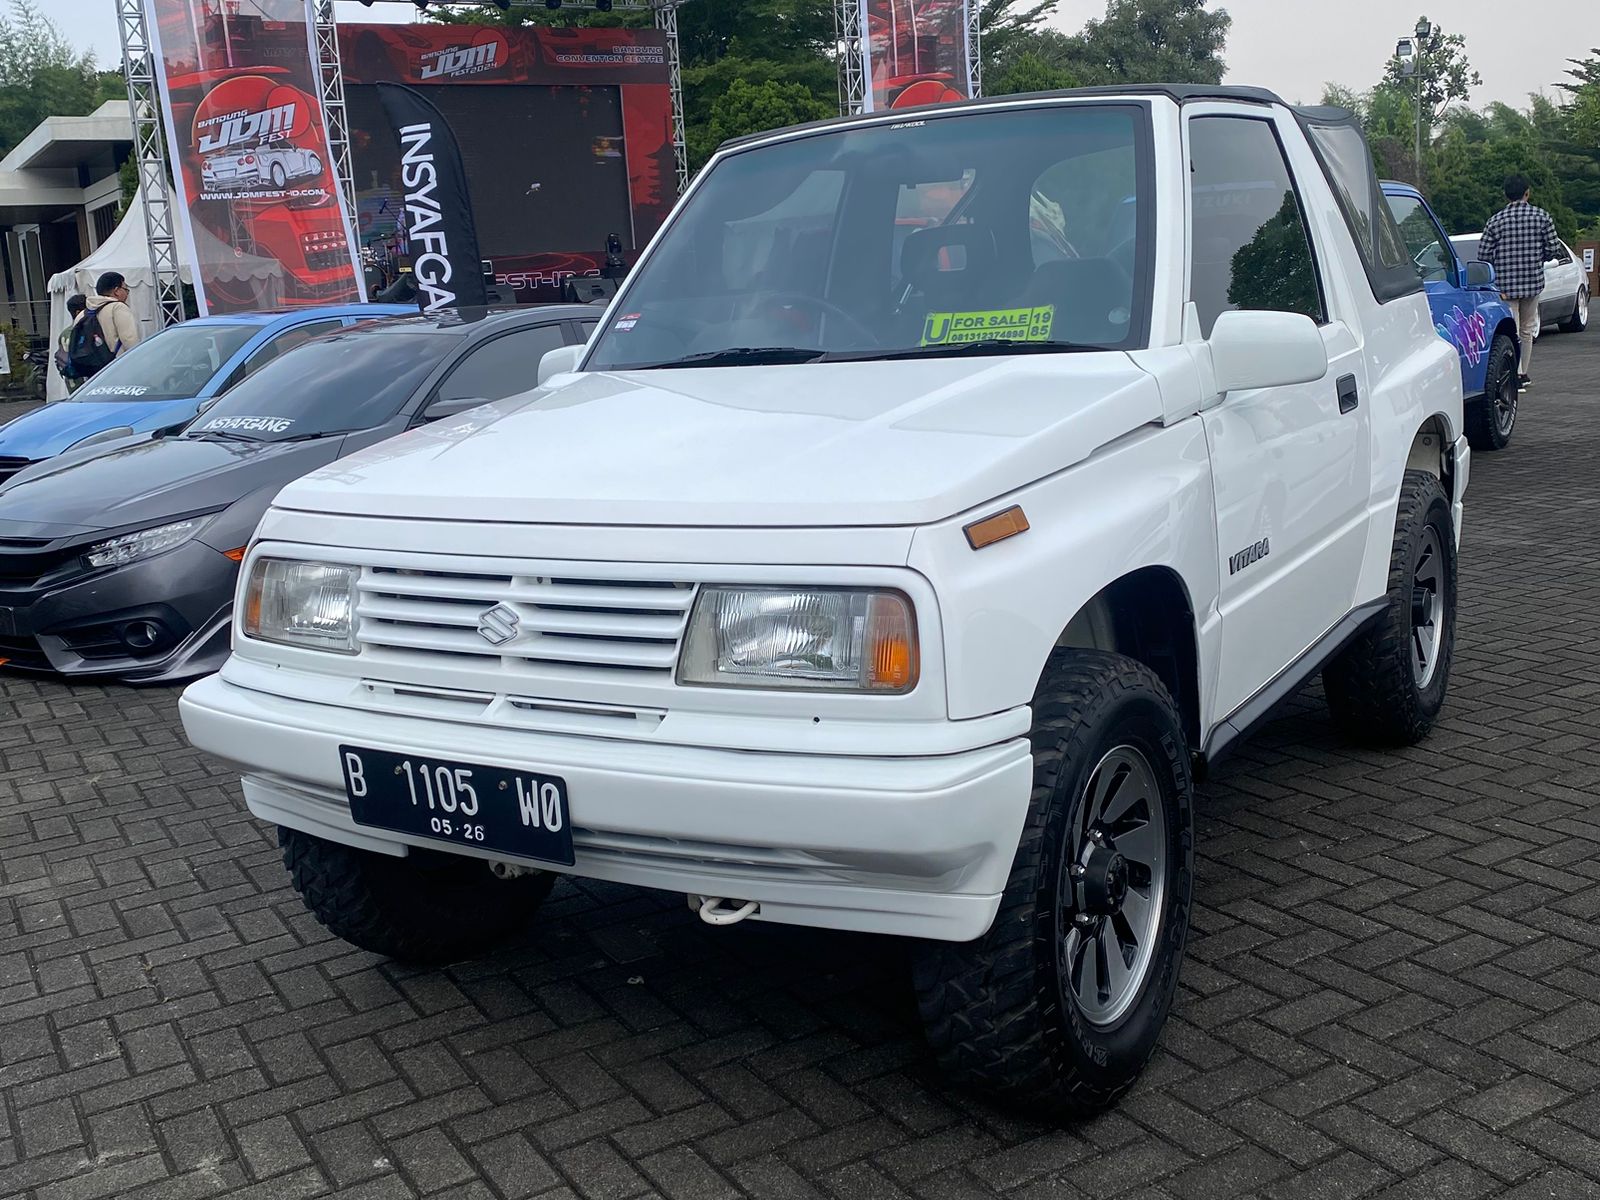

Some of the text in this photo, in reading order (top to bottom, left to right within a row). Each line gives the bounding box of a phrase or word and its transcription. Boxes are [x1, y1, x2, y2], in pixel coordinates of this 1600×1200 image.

[612, 45, 663, 54] BANDUNG
[421, 41, 498, 80] JDM
[556, 54, 664, 64] CONVENTION CENTRE
[197, 109, 248, 129] BANDUNG
[198, 103, 296, 154] JDM
[259, 129, 293, 146] FEST
[200, 188, 327, 201] WWW.JDMFEST-ID.COM
[954, 313, 1029, 328] FOR SALE
[1033, 312, 1052, 325] 19
[924, 318, 951, 343] U
[1030, 325, 1049, 338] 85
[1229, 537, 1270, 576] VITARA
[345, 752, 367, 798] B
[402, 760, 479, 816] 1105
